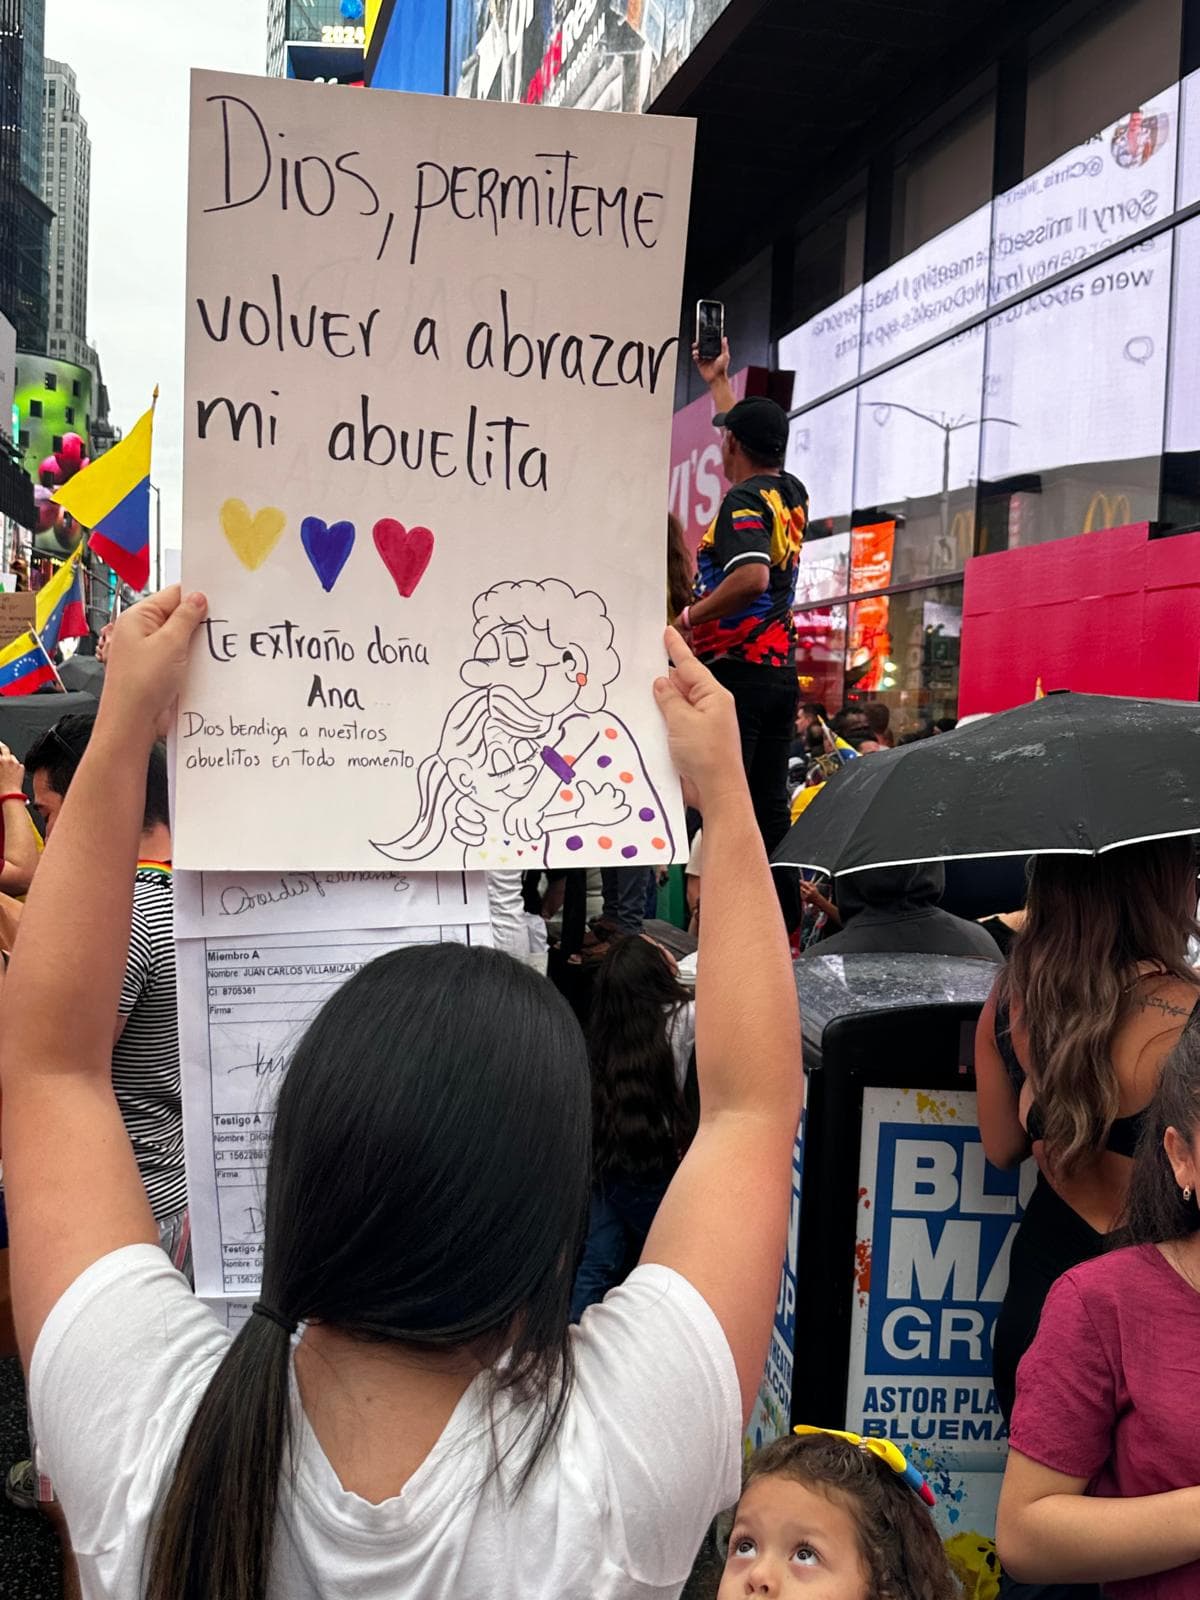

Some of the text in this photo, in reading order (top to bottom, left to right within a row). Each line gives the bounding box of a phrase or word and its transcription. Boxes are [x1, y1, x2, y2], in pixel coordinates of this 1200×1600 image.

[321, 25, 366, 44] 2024
[204, 95, 394, 261] Dios,
[413, 316, 440, 361] a
[466, 289, 679, 394] abrazar
[197, 391, 280, 449] mi
[366, 625, 430, 666] doña
[306, 673, 365, 711] Ana
[182, 711, 225, 739] Dios
[299, 726, 309, 738] a
[207, 950, 260, 962] Miembro A
[243, 967, 266, 977] JUAN
[267, 966, 303, 976] CARLOS
[305, 964, 357, 976] VILLAMIZAR
[214, 1114, 261, 1127] Testigo A
[223, 1244, 265, 1255] Testigo A
[881, 1306, 999, 1361] GR
[862, 1386, 947, 1414] ASTOR
